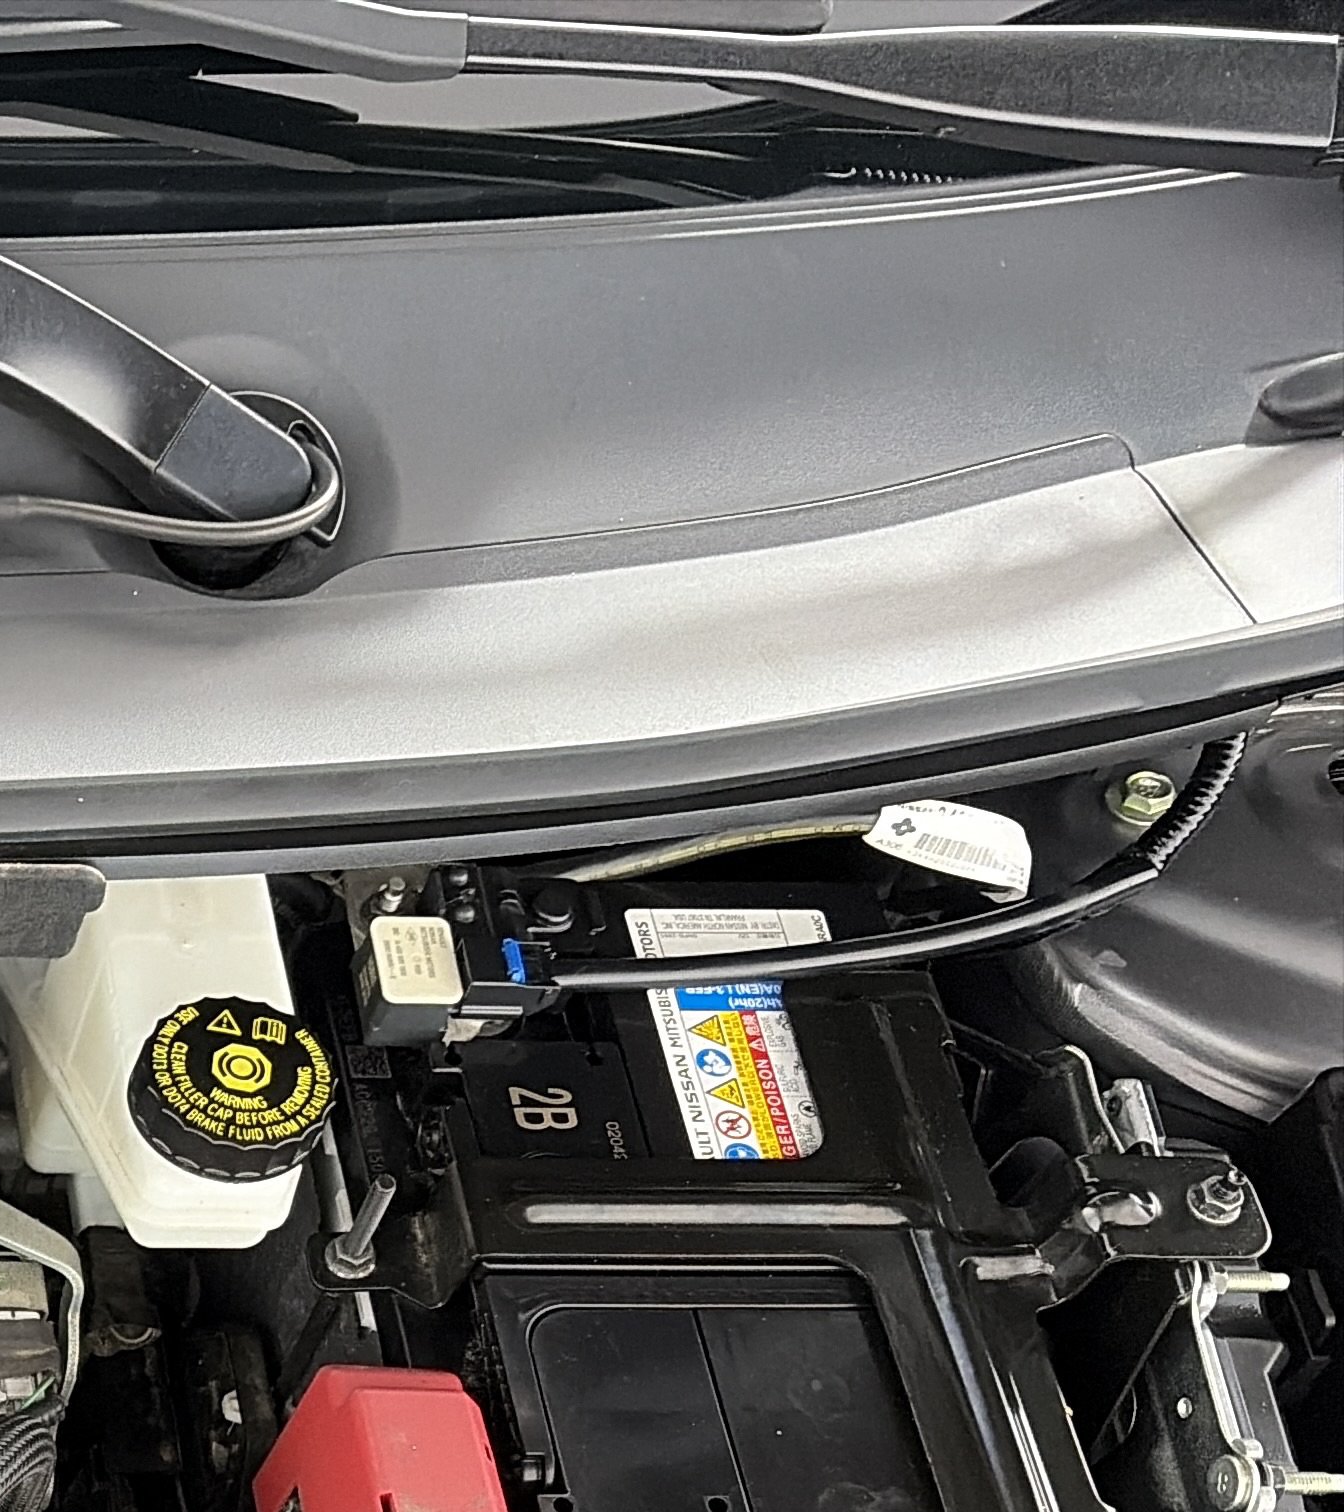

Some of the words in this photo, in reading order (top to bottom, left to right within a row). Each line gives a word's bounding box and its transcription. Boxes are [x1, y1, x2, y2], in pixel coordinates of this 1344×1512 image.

[176, 1006, 200, 1026] USE
[157, 1019, 179, 1045] ONLY
[170, 1041, 189, 1075] CLEAN
[294, 1028, 331, 1083] CONTAINER
[154, 1071, 173, 1087] OR
[175, 1074, 210, 1109] FILLER
[285, 1065, 312, 1117] REMOVING
[672, 1054, 705, 1123] NISSAN
[161, 1086, 186, 1114] DOT4
[209, 1086, 268, 1110] WARNING
[302, 1082, 331, 1121] SEALED
[508, 1086, 578, 1130] 2B
[185, 1108, 227, 1136] BRAKE
[206, 1104, 234, 1122] CAP
[235, 1108, 286, 1126] BEFORE
[299, 1114, 310, 1127] A
[228, 1125, 264, 1141] FLUID
[267, 1118, 301, 1140] FROM
